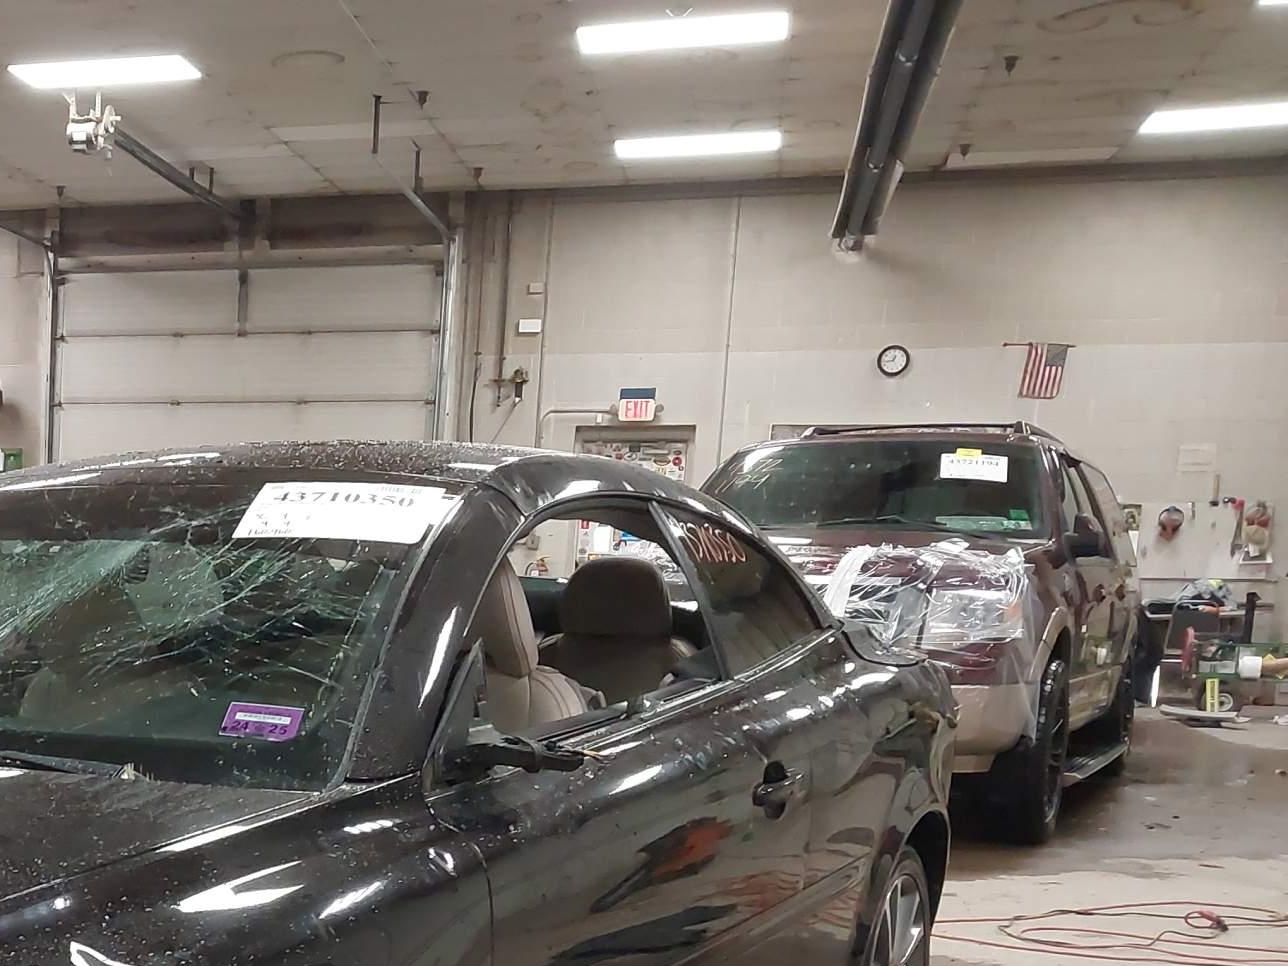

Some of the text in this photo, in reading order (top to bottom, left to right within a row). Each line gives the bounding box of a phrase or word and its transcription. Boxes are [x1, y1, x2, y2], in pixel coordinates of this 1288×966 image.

[625, 400, 651, 418] EXIT
[274, 492, 416, 507] 43710350
[230, 720, 289, 736] 24 25
